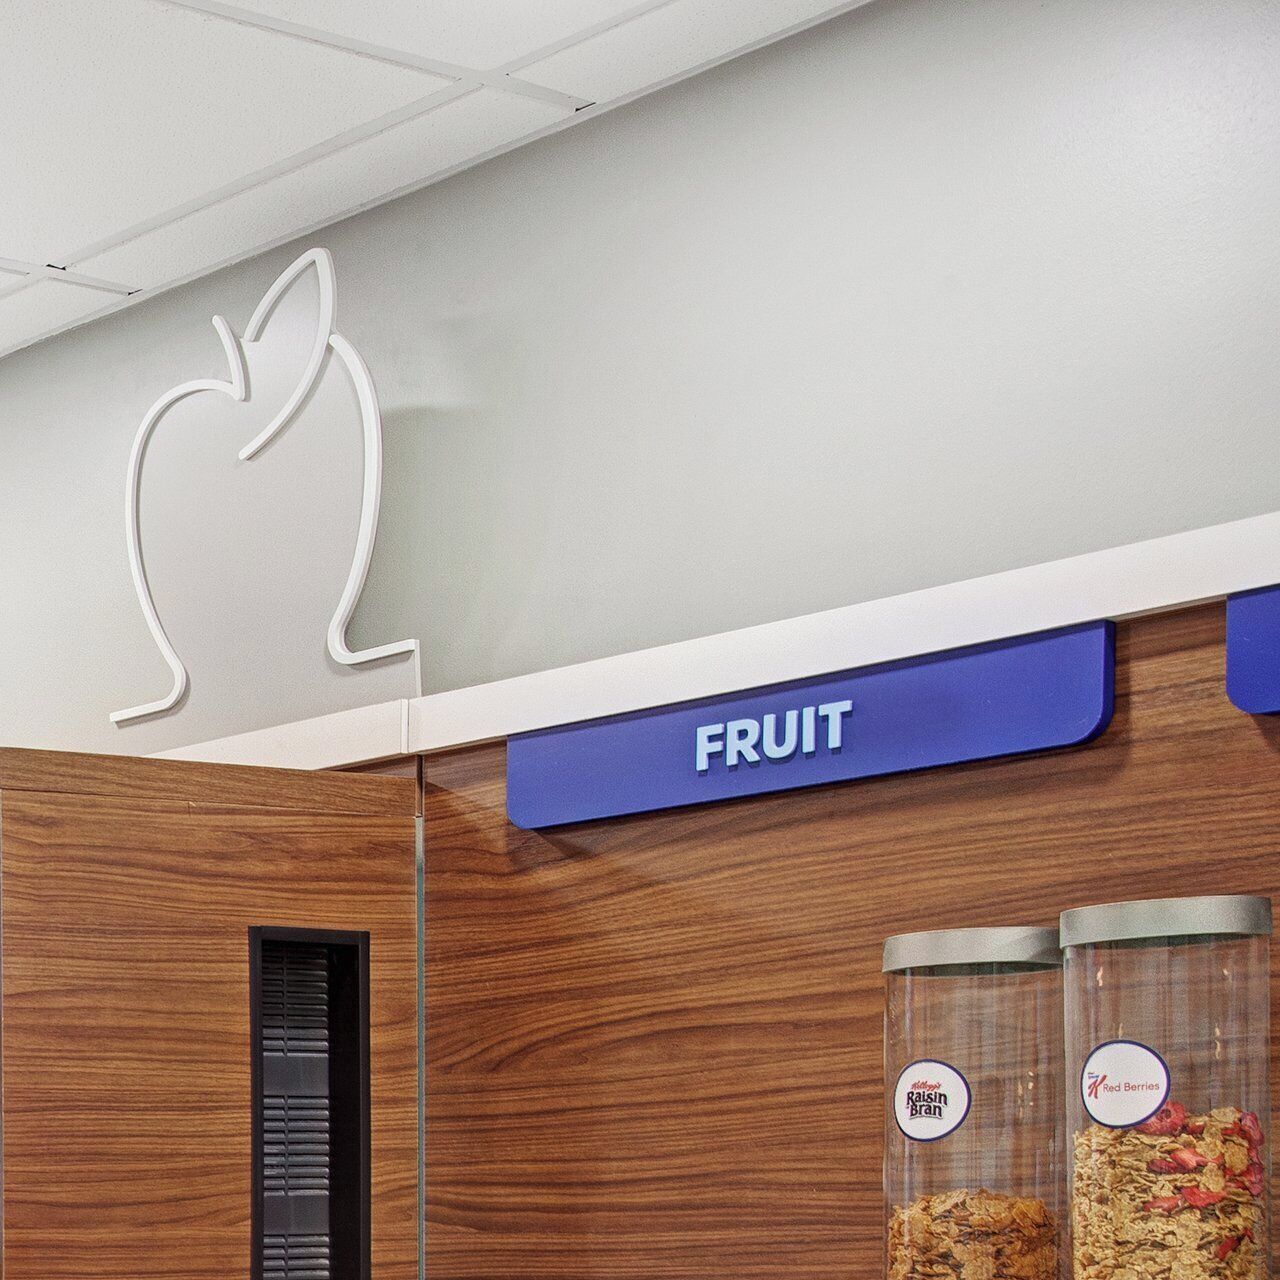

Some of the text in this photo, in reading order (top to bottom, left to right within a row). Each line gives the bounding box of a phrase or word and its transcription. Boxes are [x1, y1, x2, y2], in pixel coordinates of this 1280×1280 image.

[695, 699, 853, 772] FRUIT
[1103, 1082, 1160, 1092] Red Berries
[907, 1091, 948, 1106] Raisin
[910, 1103, 942, 1118] Bran
